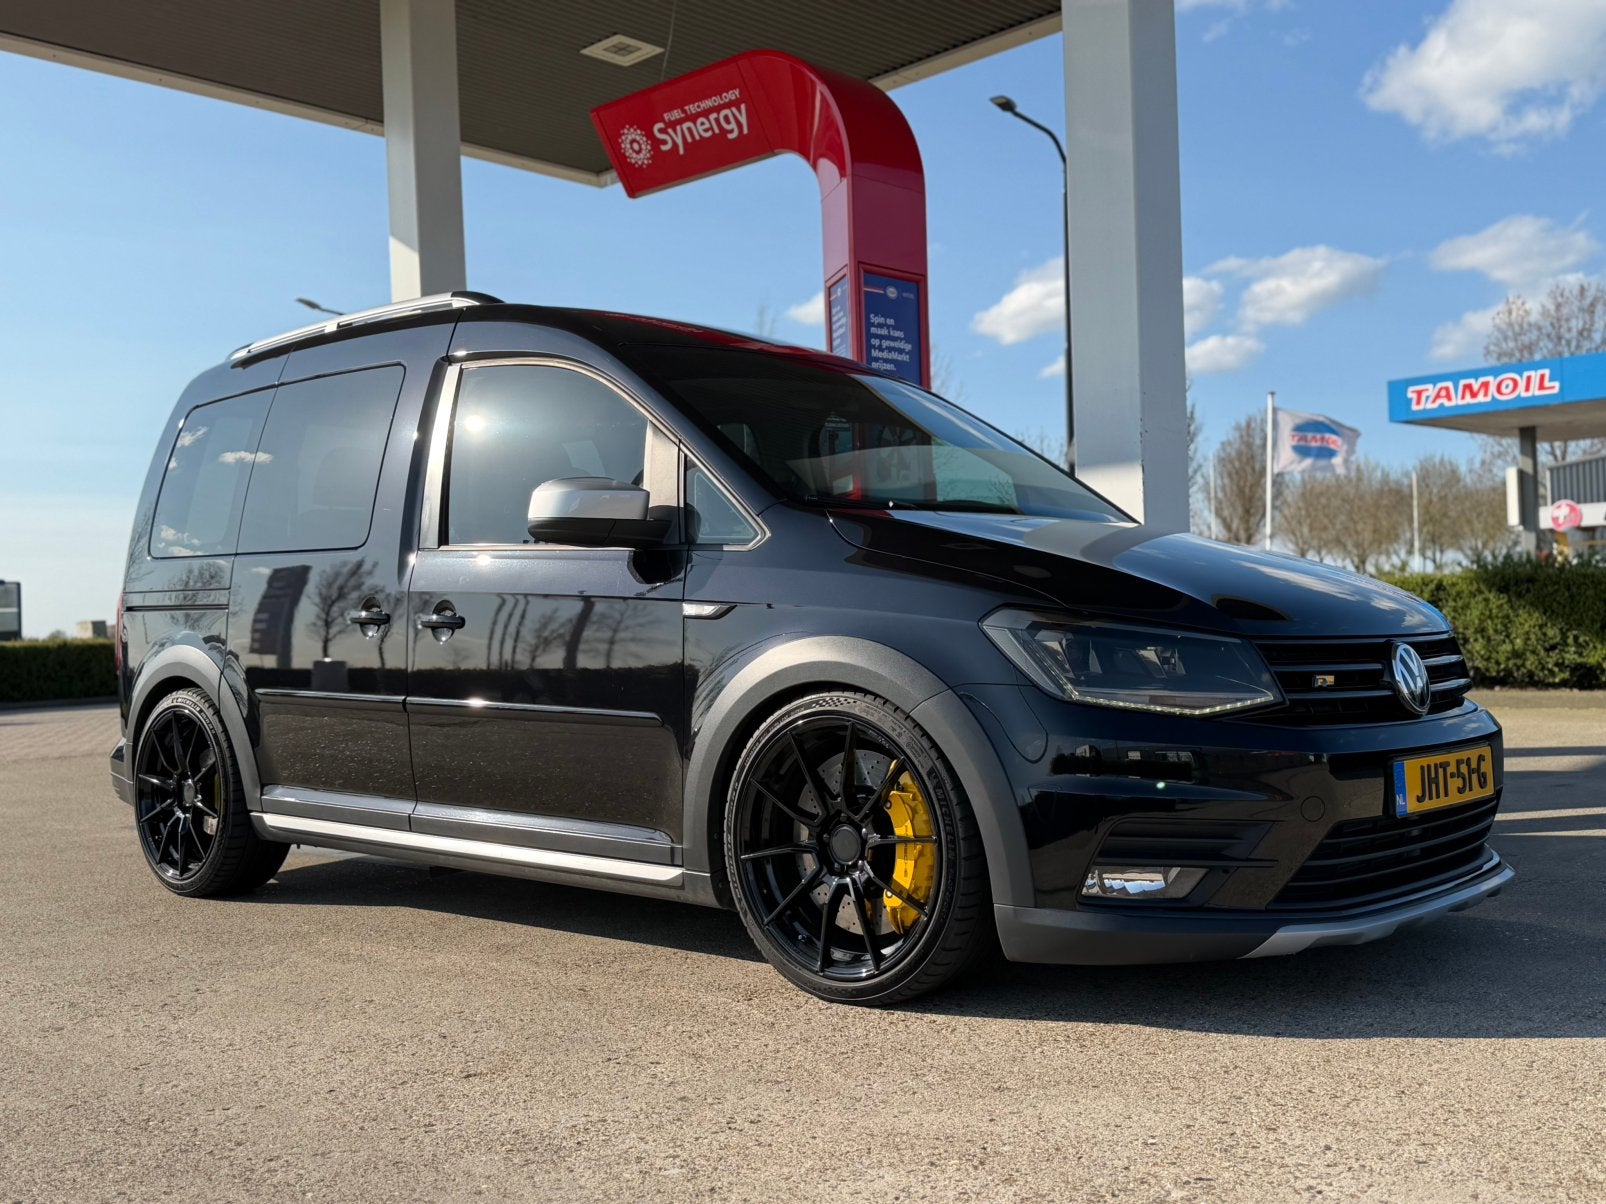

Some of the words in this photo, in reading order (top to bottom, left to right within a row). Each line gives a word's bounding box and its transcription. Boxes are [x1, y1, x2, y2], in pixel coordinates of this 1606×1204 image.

[663, 108, 685, 122] FUEL
[684, 88, 740, 115] TECHNOLOGY
[653, 103, 748, 155] Synergy
[870, 313, 885, 326] Spin
[886, 318, 895, 326] en
[870, 327, 889, 336] maak
[890, 327, 905, 338] kans
[870, 338, 880, 347] op
[871, 348, 910, 362] MediaMarkt
[1407, 369, 1559, 410] TAMOIL
[1416, 754, 1488, 803] JHT-51-G
[1396, 794, 1405, 805] NL
[936, 787, 956, 860] MICHELIN
